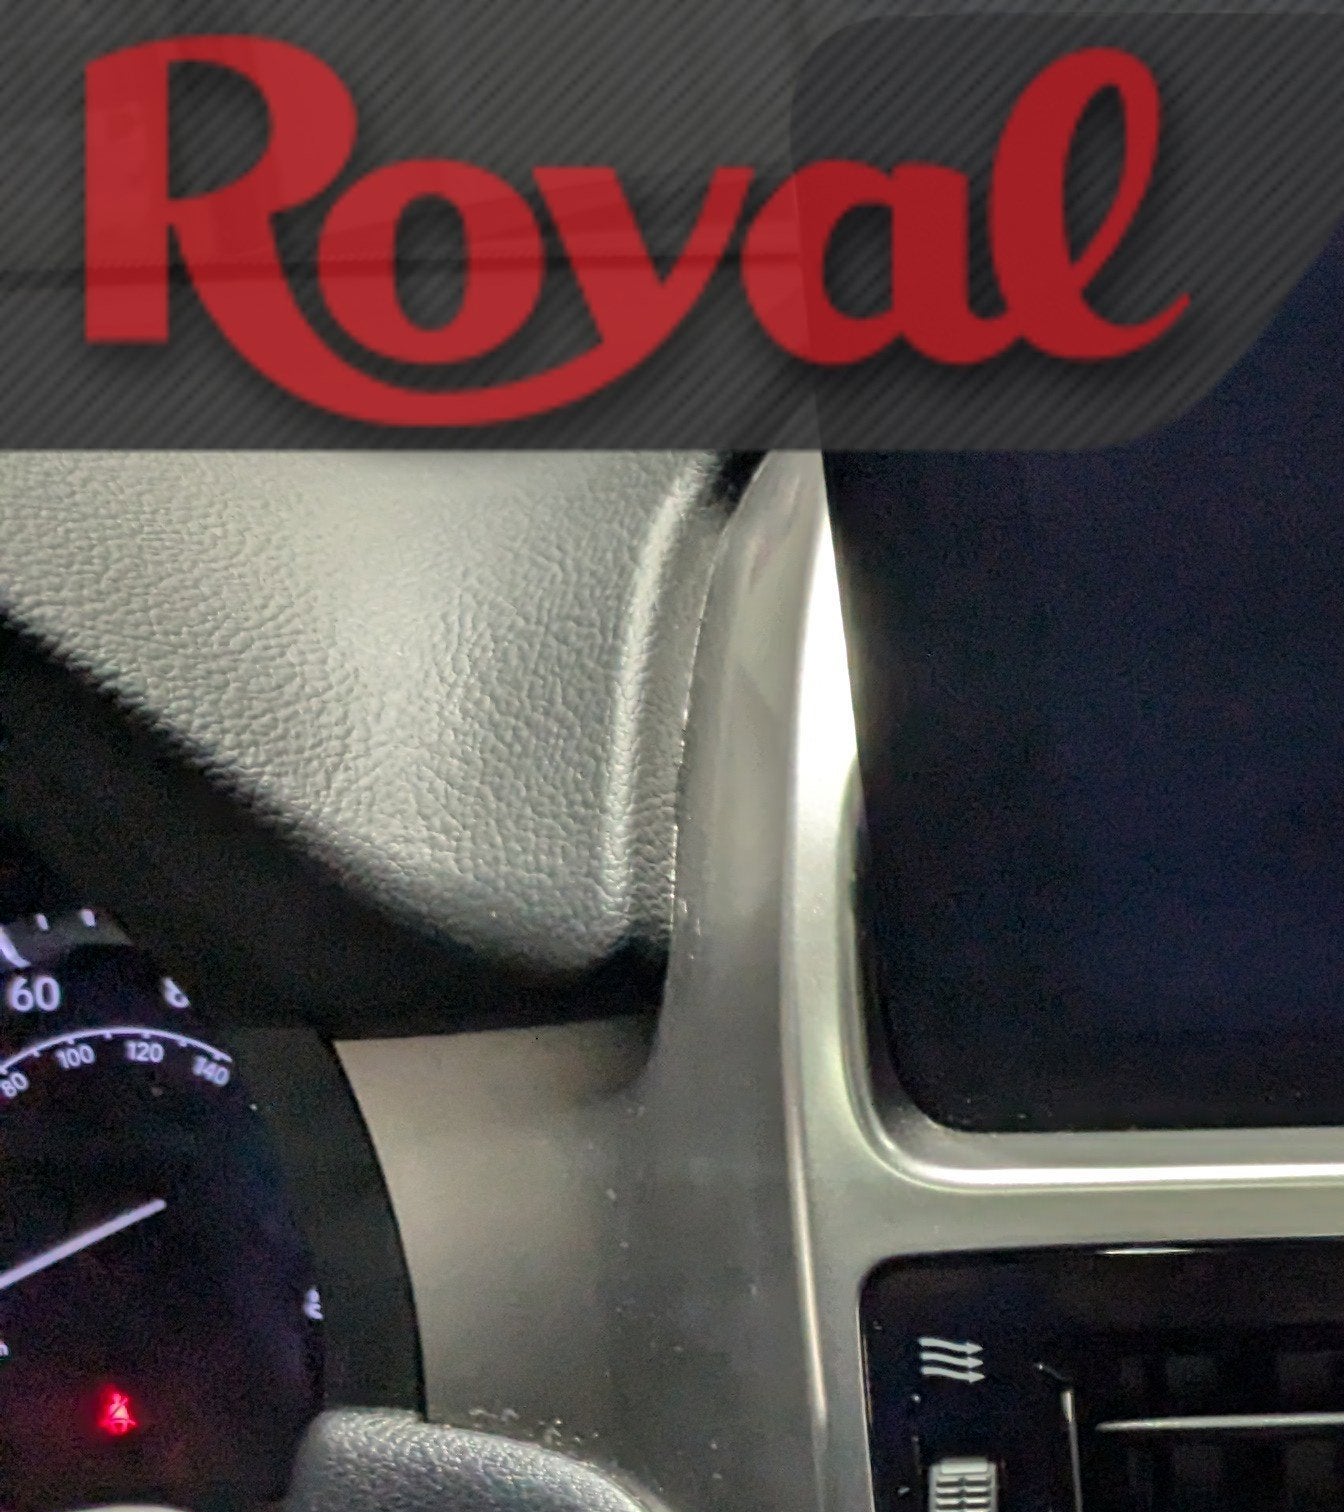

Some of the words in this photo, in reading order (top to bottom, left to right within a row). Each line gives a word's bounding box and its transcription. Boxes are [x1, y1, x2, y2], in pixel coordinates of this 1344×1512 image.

[8, 975, 61, 1012] 60
[55, 1044, 96, 1070] 100
[125, 1040, 165, 1063] 120
[192, 1055, 231, 1087] 140
